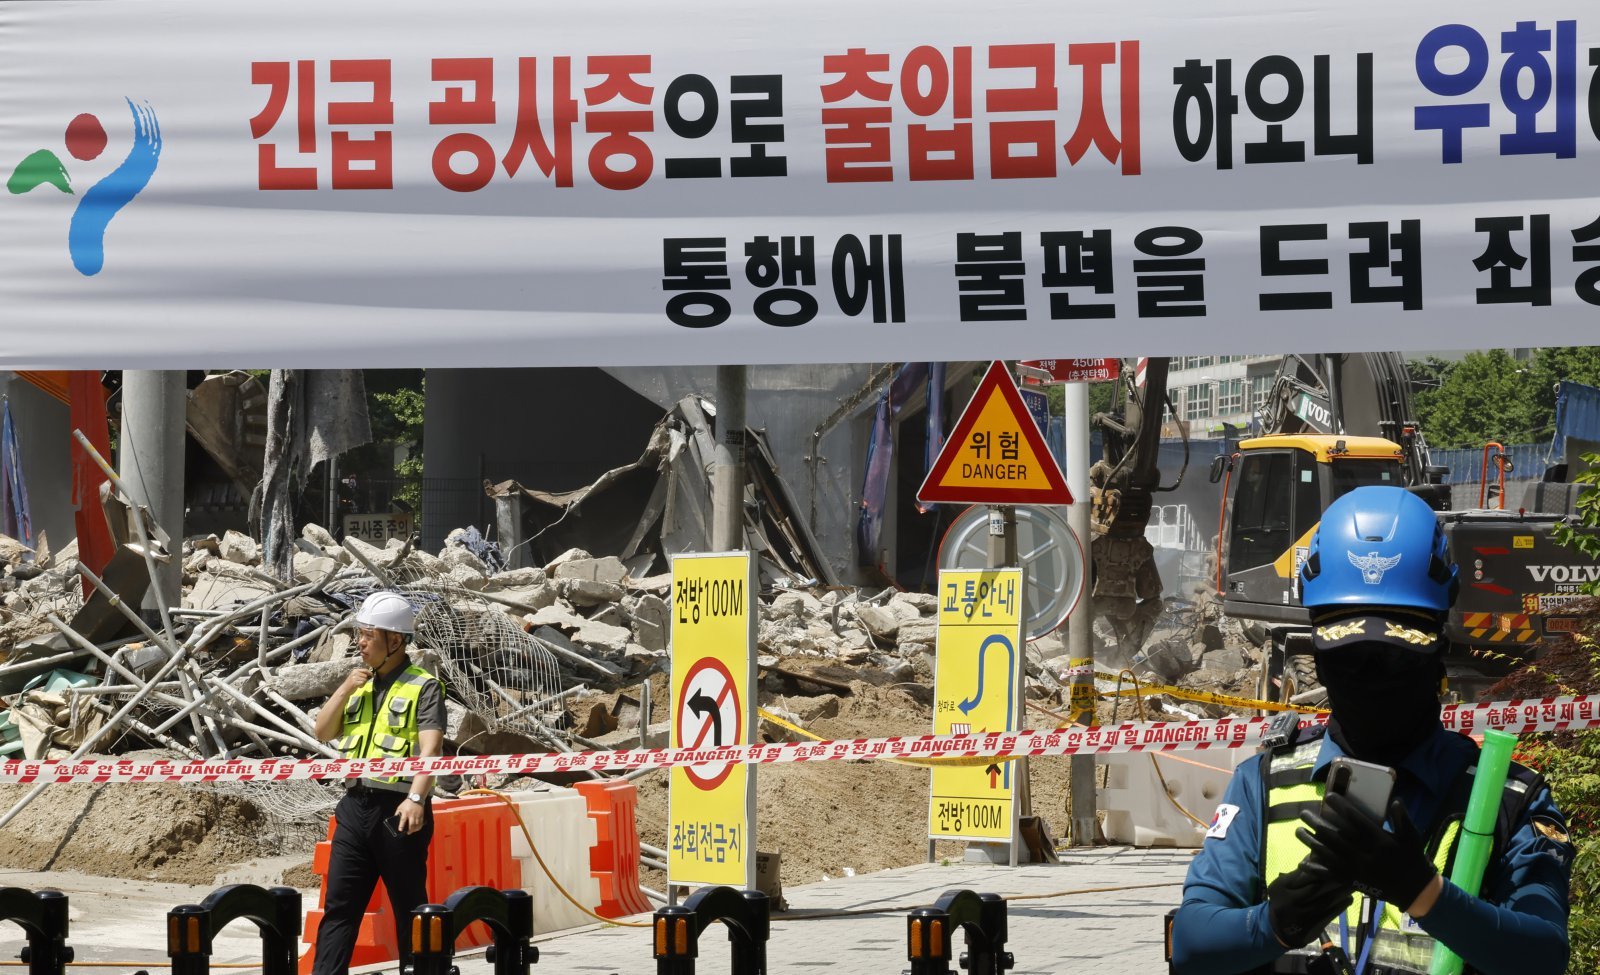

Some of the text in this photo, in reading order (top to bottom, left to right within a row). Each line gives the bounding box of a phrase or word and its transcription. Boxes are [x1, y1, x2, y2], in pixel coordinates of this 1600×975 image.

[249, 19, 1600, 192] 긴급 공사중으로 출입금지 하오니 우회
[661, 233, 905, 328] 통행에
[955, 225, 1207, 322] 불편을
[1259, 219, 1423, 311] 드려
[1072, 358, 1105, 368] 450m
[1308, 401, 1332, 427] VOL
[970, 431, 1019, 460] 위험
[962, 463, 1027, 480] DANGER
[349, 520, 408, 539] 공사중 주의
[676, 577, 743, 624] 전방100M
[943, 579, 1015, 618] 교통안내
[937, 700, 956, 713] 청파로
[1442, 709, 1474, 729] 위험
[1486, 707, 1518, 726] 危險
[1523, 701, 1593, 724] 안전제일
[3, 764, 39, 776] 위험
[54, 764, 89, 775] 危險
[97, 764, 174, 776] 안전제일
[181, 764, 252, 775] DANGER!
[259, 763, 295, 775] 위험
[308, 762, 341, 773] 危險
[350, 761, 426, 773] 안전제일
[431, 759, 500, 770] DANGER!
[506, 757, 541, 769] 위험
[553, 755, 586, 767] 危險
[595, 753, 668, 766] 안전제일
[673, 750, 741, 762] DANGER!
[747, 747, 782, 760] 위험
[793, 745, 826, 757] 危險
[834, 741, 904, 755] 안전제일
[911, 740, 977, 752] DANGER!
[983, 737, 1016, 750] 위험
[1028, 734, 1060, 748] 危險
[1067, 730, 1138, 748] 안전제일
[1143, 727, 1208, 743] DANGER!
[1214, 723, 1248, 741] 위험
[938, 801, 1002, 832] 전방100M
[673, 821, 741, 863] 좌회전금지
